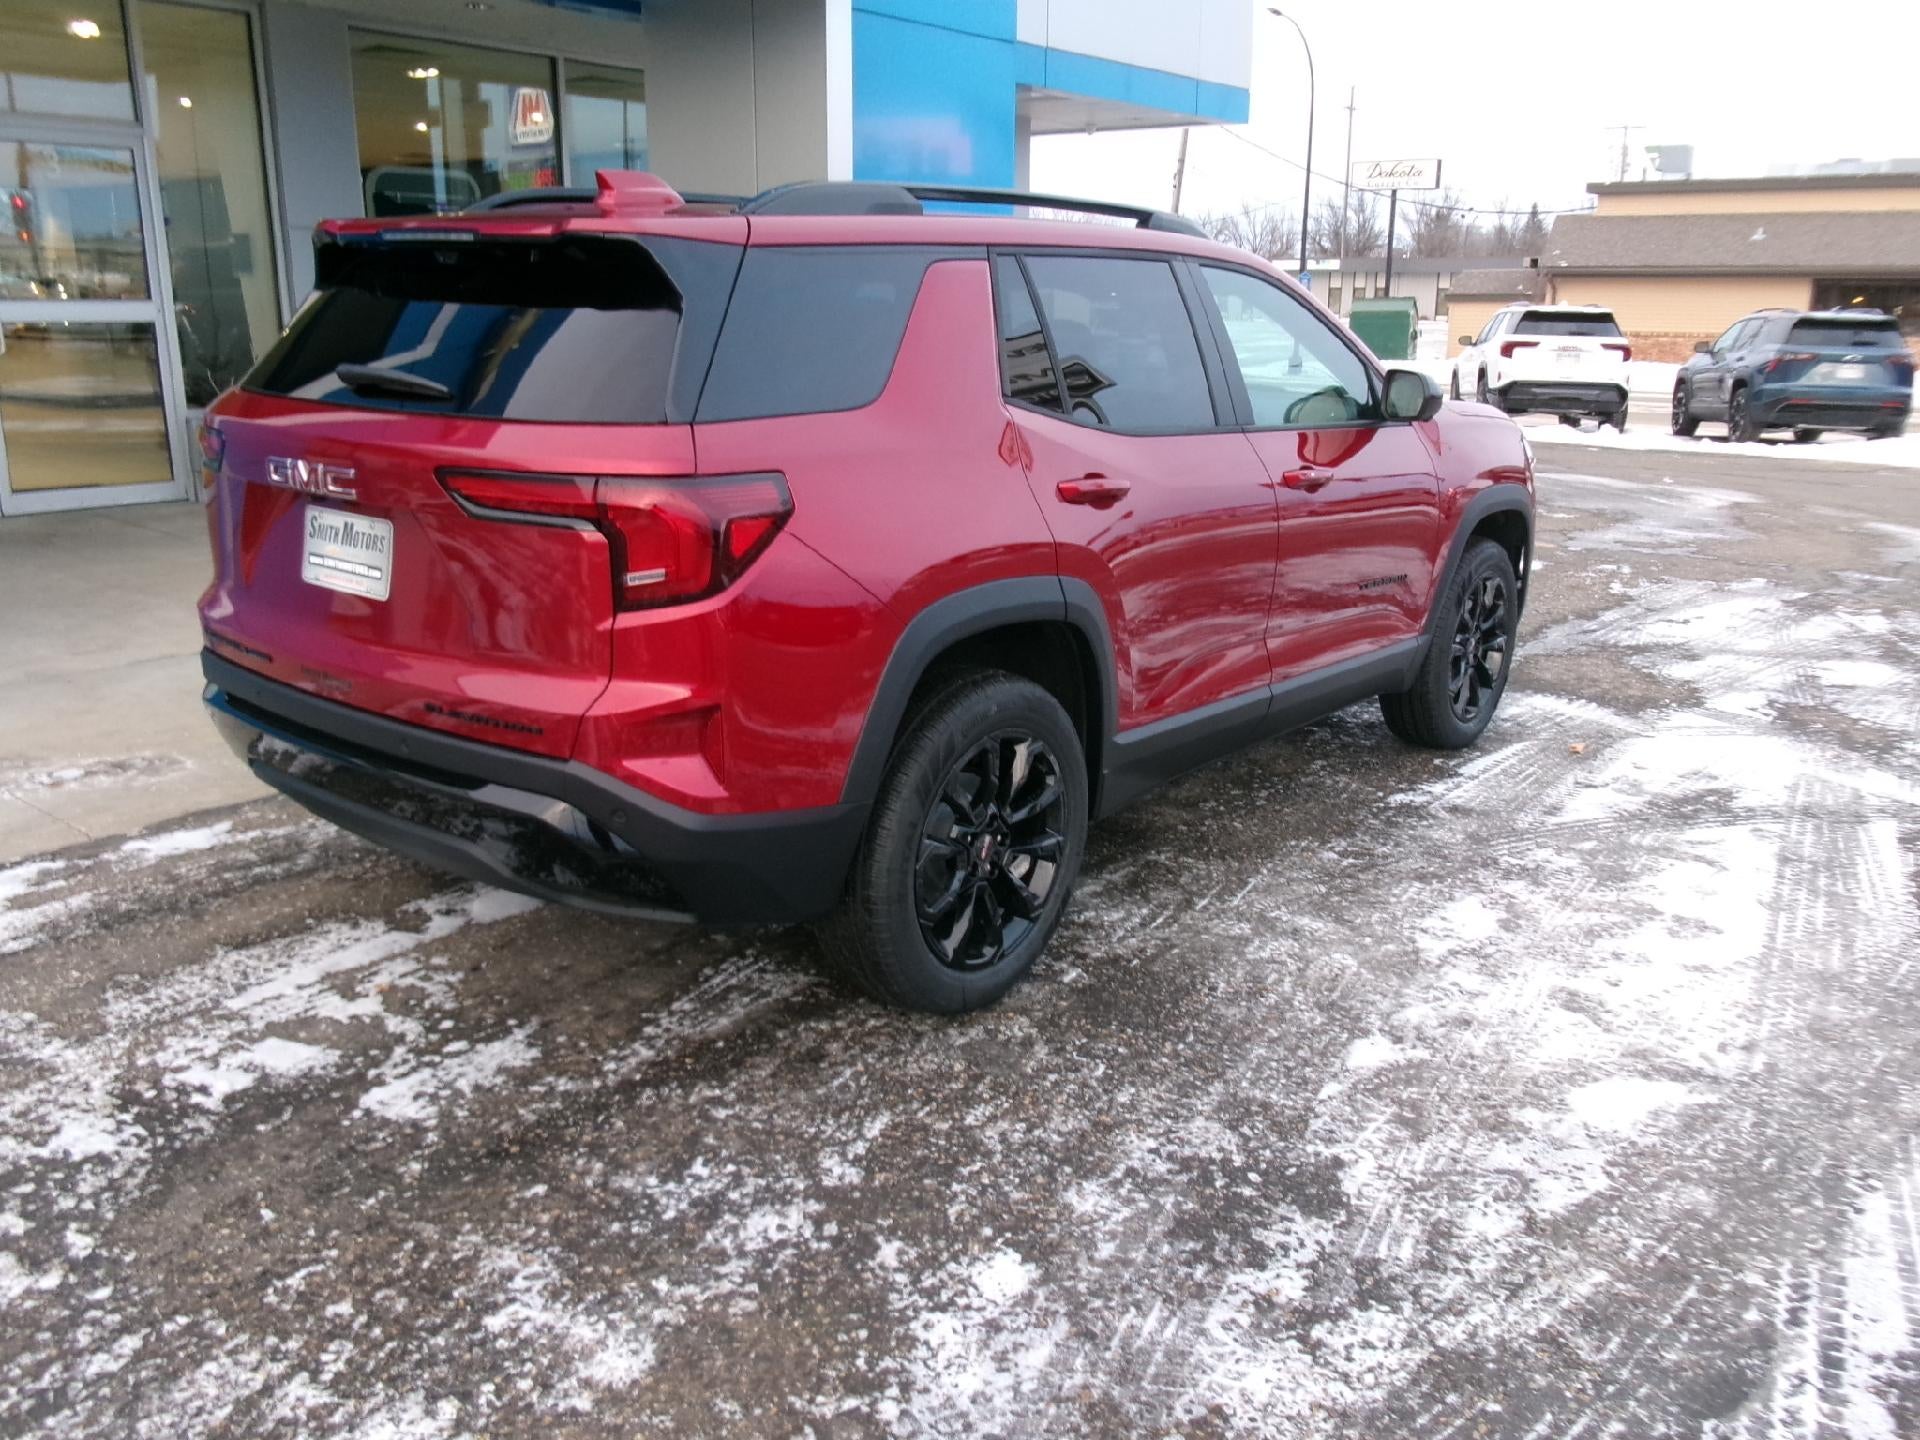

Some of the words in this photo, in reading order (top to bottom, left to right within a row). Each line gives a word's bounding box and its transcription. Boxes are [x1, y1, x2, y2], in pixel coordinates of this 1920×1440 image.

[1367, 162, 1424, 179] Dakota
[265, 456, 357, 500] GMC
[341, 520, 386, 554] MOTORS
